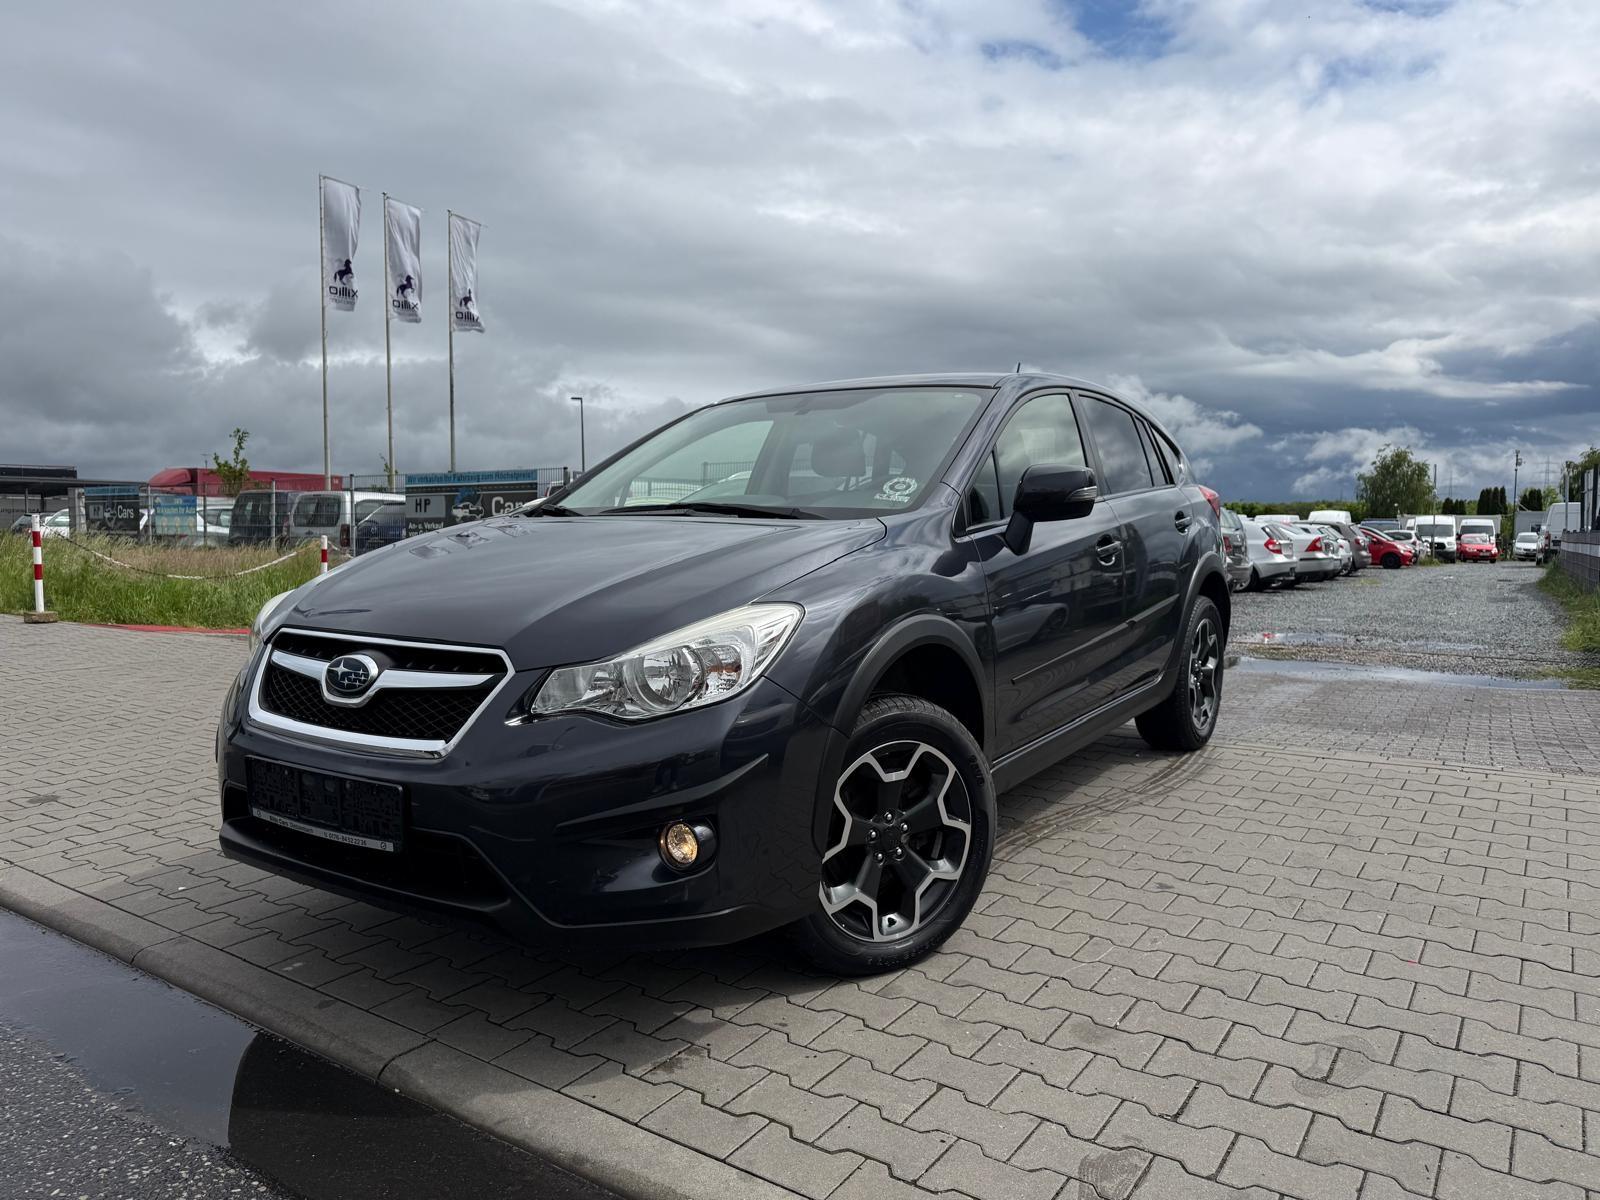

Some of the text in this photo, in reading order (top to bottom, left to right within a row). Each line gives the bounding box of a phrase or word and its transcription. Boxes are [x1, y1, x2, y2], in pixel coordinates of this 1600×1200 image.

[415, 498, 431, 511] HP
[492, 496, 523, 515] Car
[117, 505, 134, 518] Cars
[424, 522, 444, 530] Verkauf
